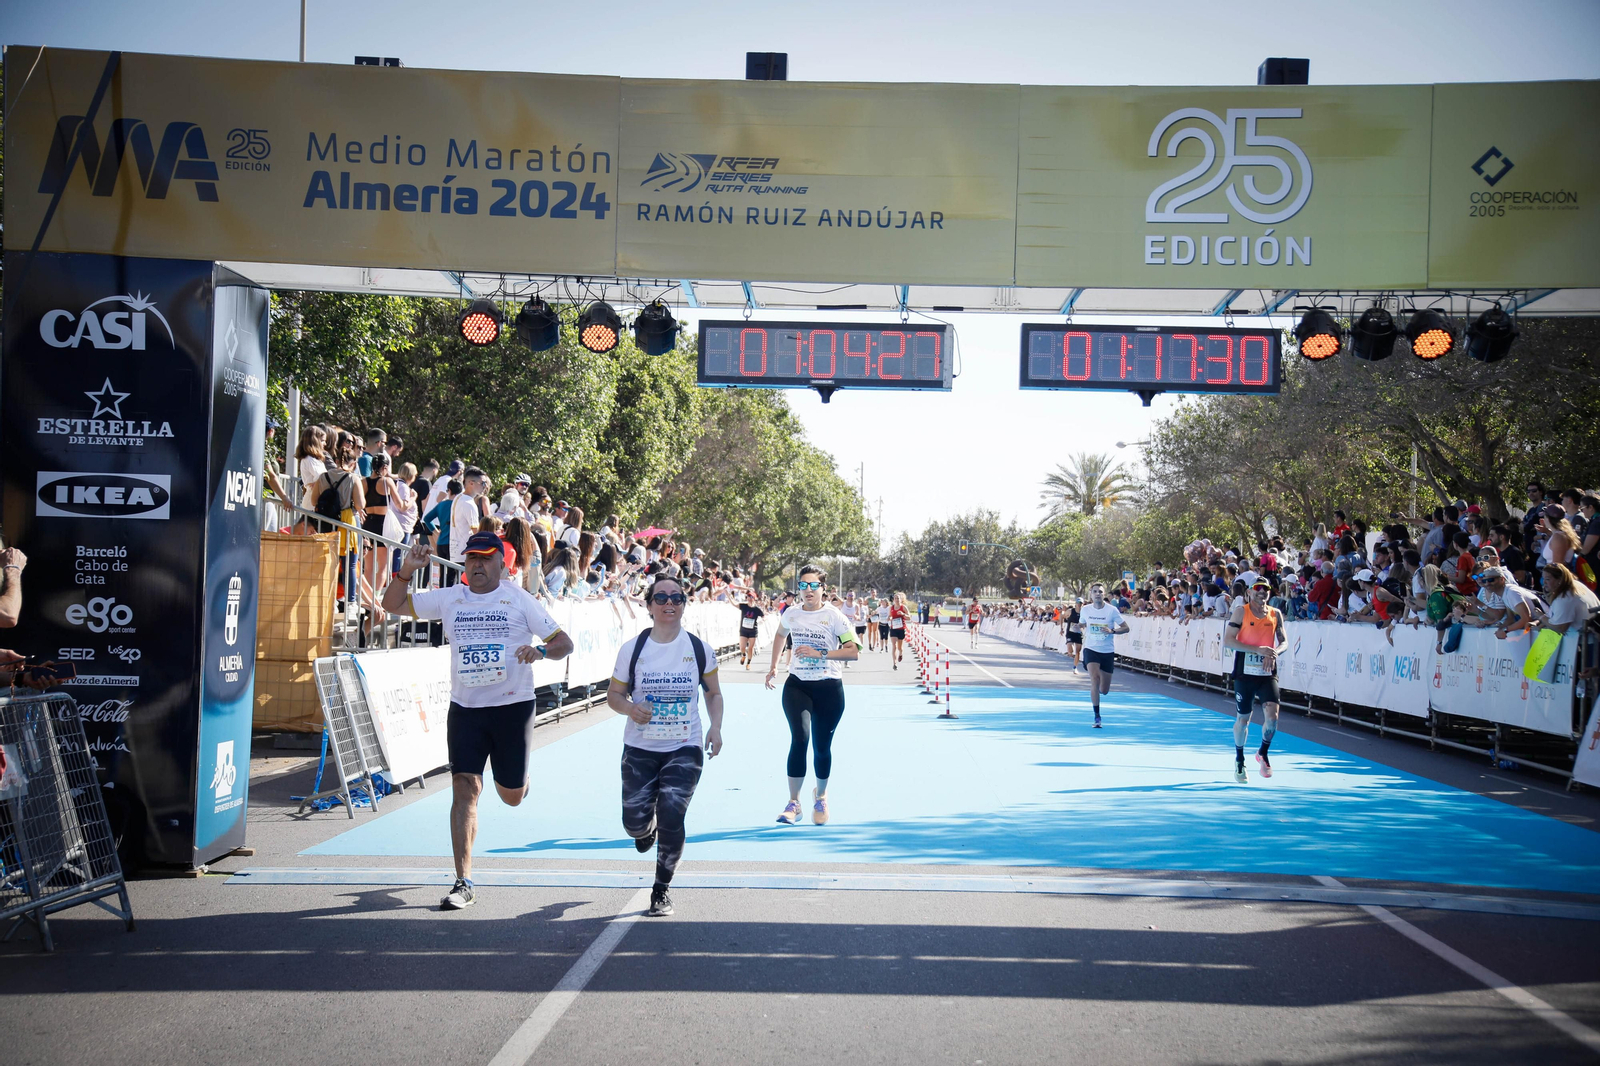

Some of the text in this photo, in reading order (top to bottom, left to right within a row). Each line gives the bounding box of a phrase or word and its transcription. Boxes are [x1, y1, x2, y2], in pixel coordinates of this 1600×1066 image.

[226, 128, 271, 159] 25
[306, 131, 611, 174] Medio Maratón
[225, 160, 271, 172] EDICIÓN
[717, 156, 780, 171] RFEA
[1145, 107, 1314, 225] 25
[710, 172, 773, 184] SERIES
[302, 170, 611, 220] Almería 2024
[705, 184, 809, 195] RUTA RUNNING
[1470, 189, 1578, 204] COOPERACIÓN
[637, 201, 945, 230] RAMÓN RUIZ ANDÚJAR
[1469, 205, 1505, 217] 2005
[1144, 229, 1312, 266] EDICIÓN
[39, 308, 146, 350] CASI
[223, 367, 260, 390] COOPERACIÓN
[223, 381, 237, 397] 2005
[37, 417, 174, 438] ESTRELLA
[68, 435, 144, 446] DE LEVANTE
[55, 484, 156, 506] IKEA
[76, 545, 127, 558] Barceló
[75, 559, 128, 572] Cabo de
[75, 572, 106, 585] Gata
[65, 596, 133, 633] ego
[454, 615, 484, 623] Almería
[58, 648, 95, 660] SER
[219, 652, 243, 671] ALMERÍA
[462, 651, 500, 665] 5633
[1392, 652, 1420, 683] NEXAL
[1446, 652, 1474, 673] ALMERÍA
[71, 677, 88, 685] Voz
[89, 677, 100, 685] de
[101, 677, 138, 686] Almería
[225, 672, 239, 683] CIUDAD
[59, 736, 131, 753] Analucía
